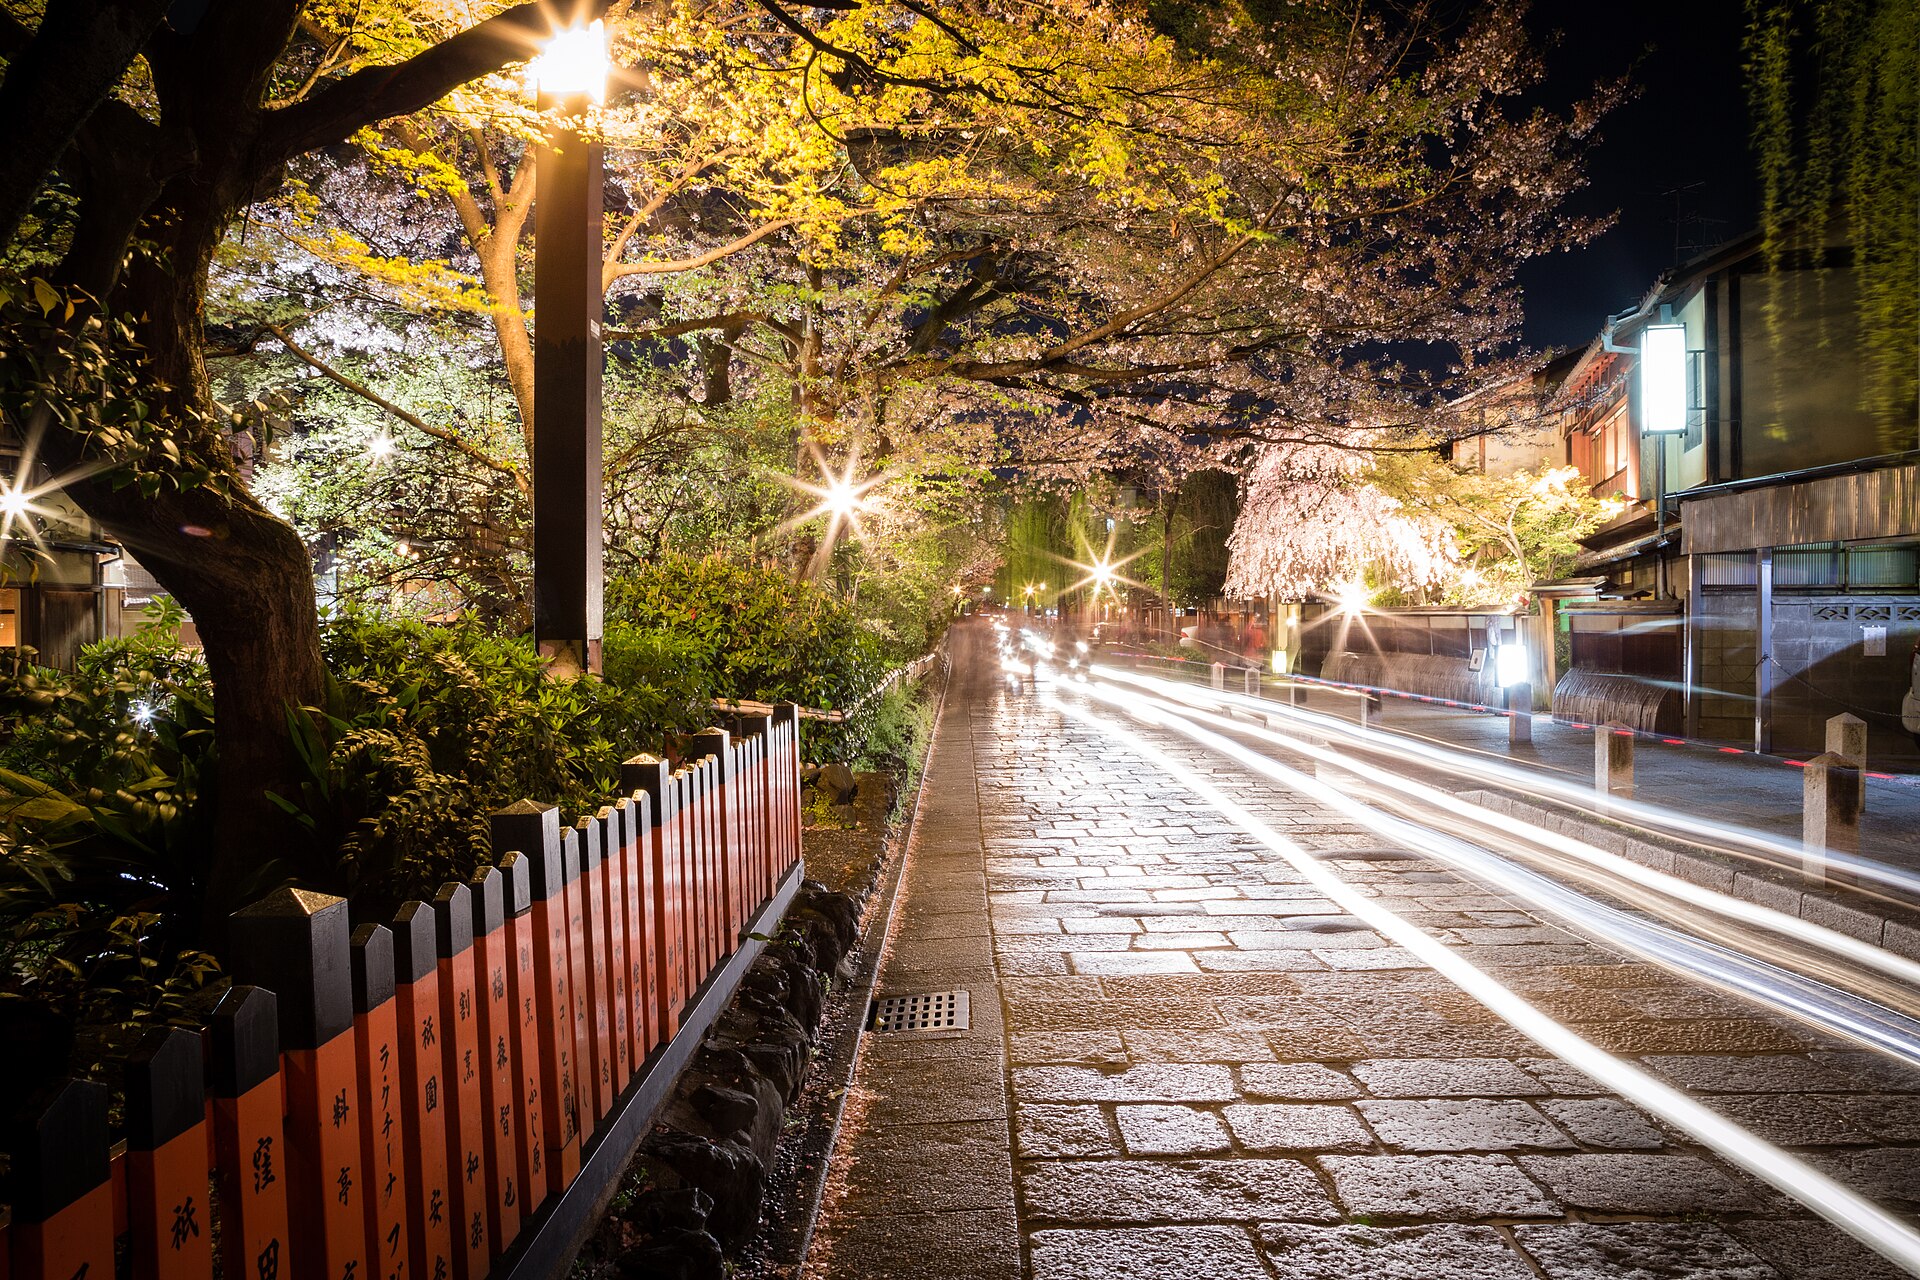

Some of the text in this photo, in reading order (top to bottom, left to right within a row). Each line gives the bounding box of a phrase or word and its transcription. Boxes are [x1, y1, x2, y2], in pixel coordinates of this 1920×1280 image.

[420, 1015, 438, 1114] 祇園
[459, 988, 475, 1084] 割烹
[171, 1195, 200, 1252] 祇
